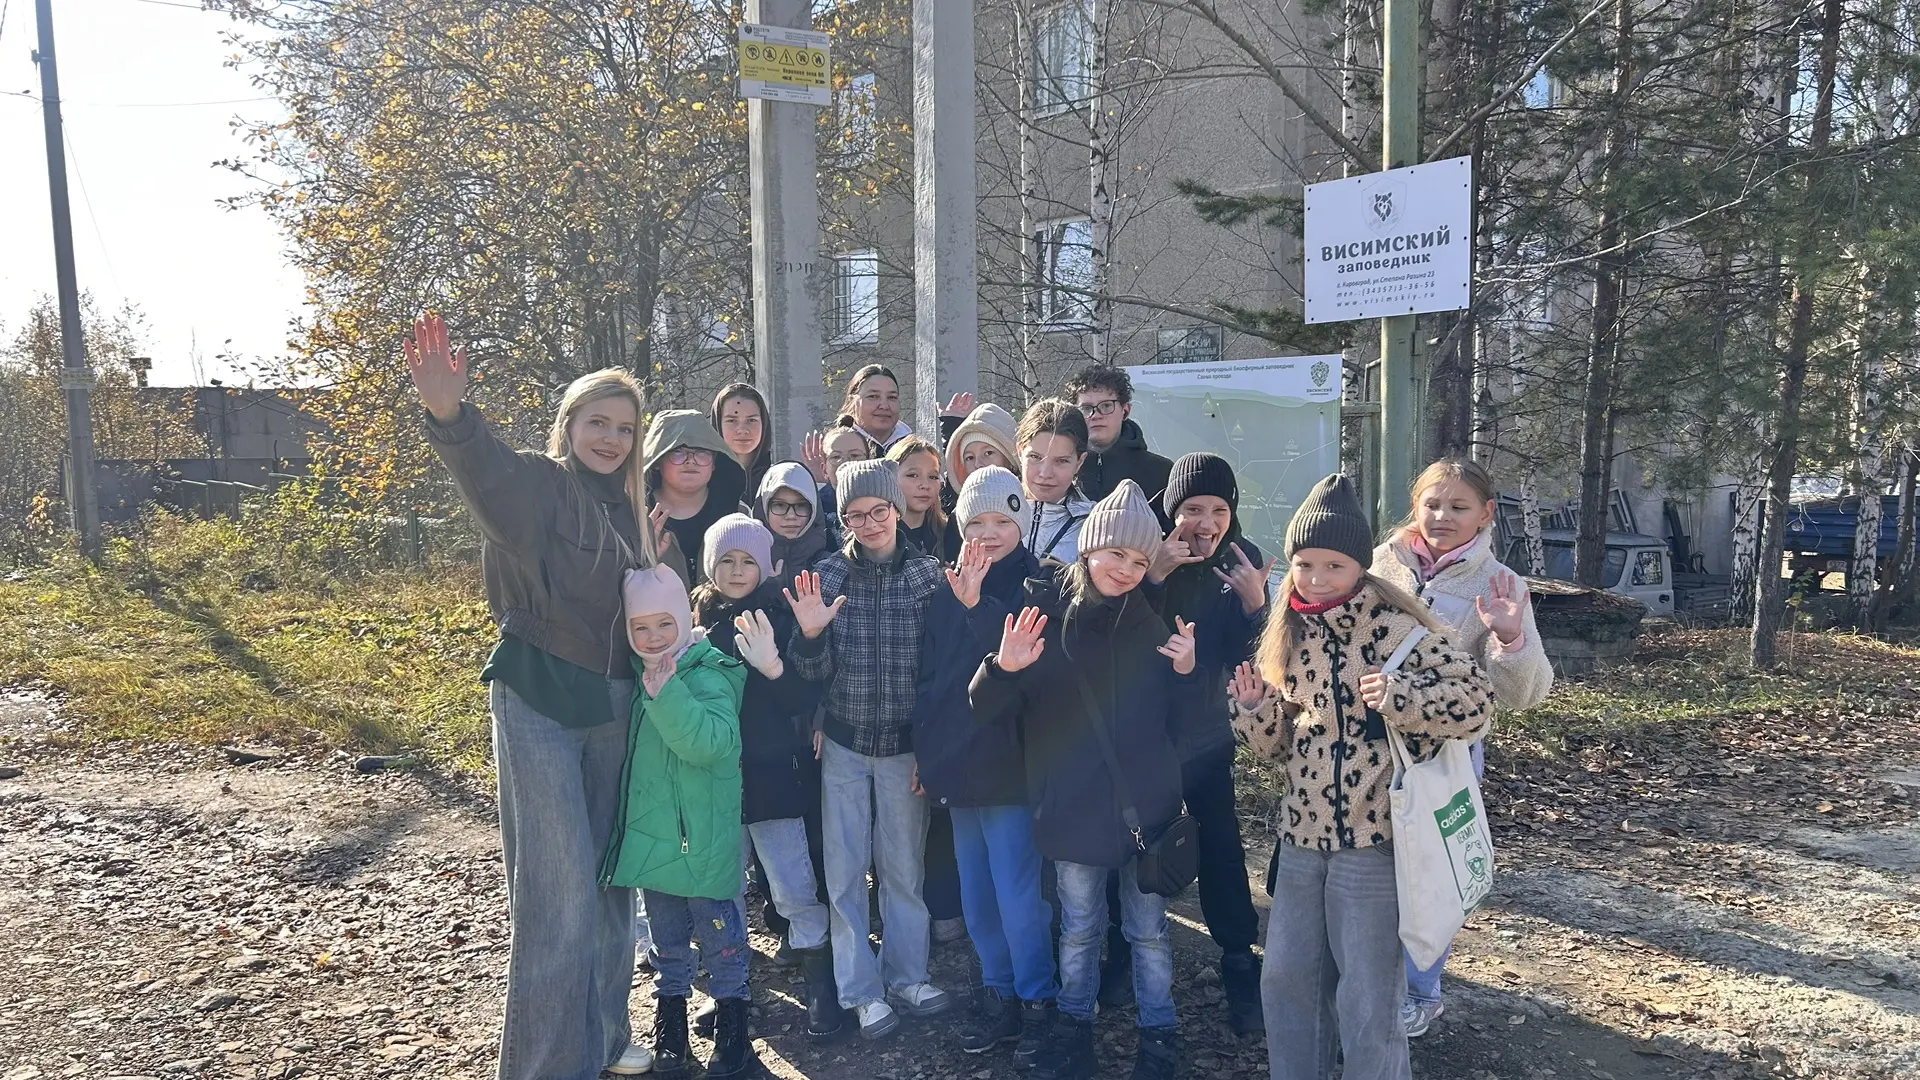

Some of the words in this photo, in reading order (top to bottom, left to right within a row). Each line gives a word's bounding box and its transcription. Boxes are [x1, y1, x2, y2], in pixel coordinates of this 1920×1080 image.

[1321, 225, 1450, 261] ВИСИМСКИЙ
[1338, 253, 1431, 274] заповедник
[1427, 270, 1435, 278] 23
[1440, 805, 1467, 829] adidas
